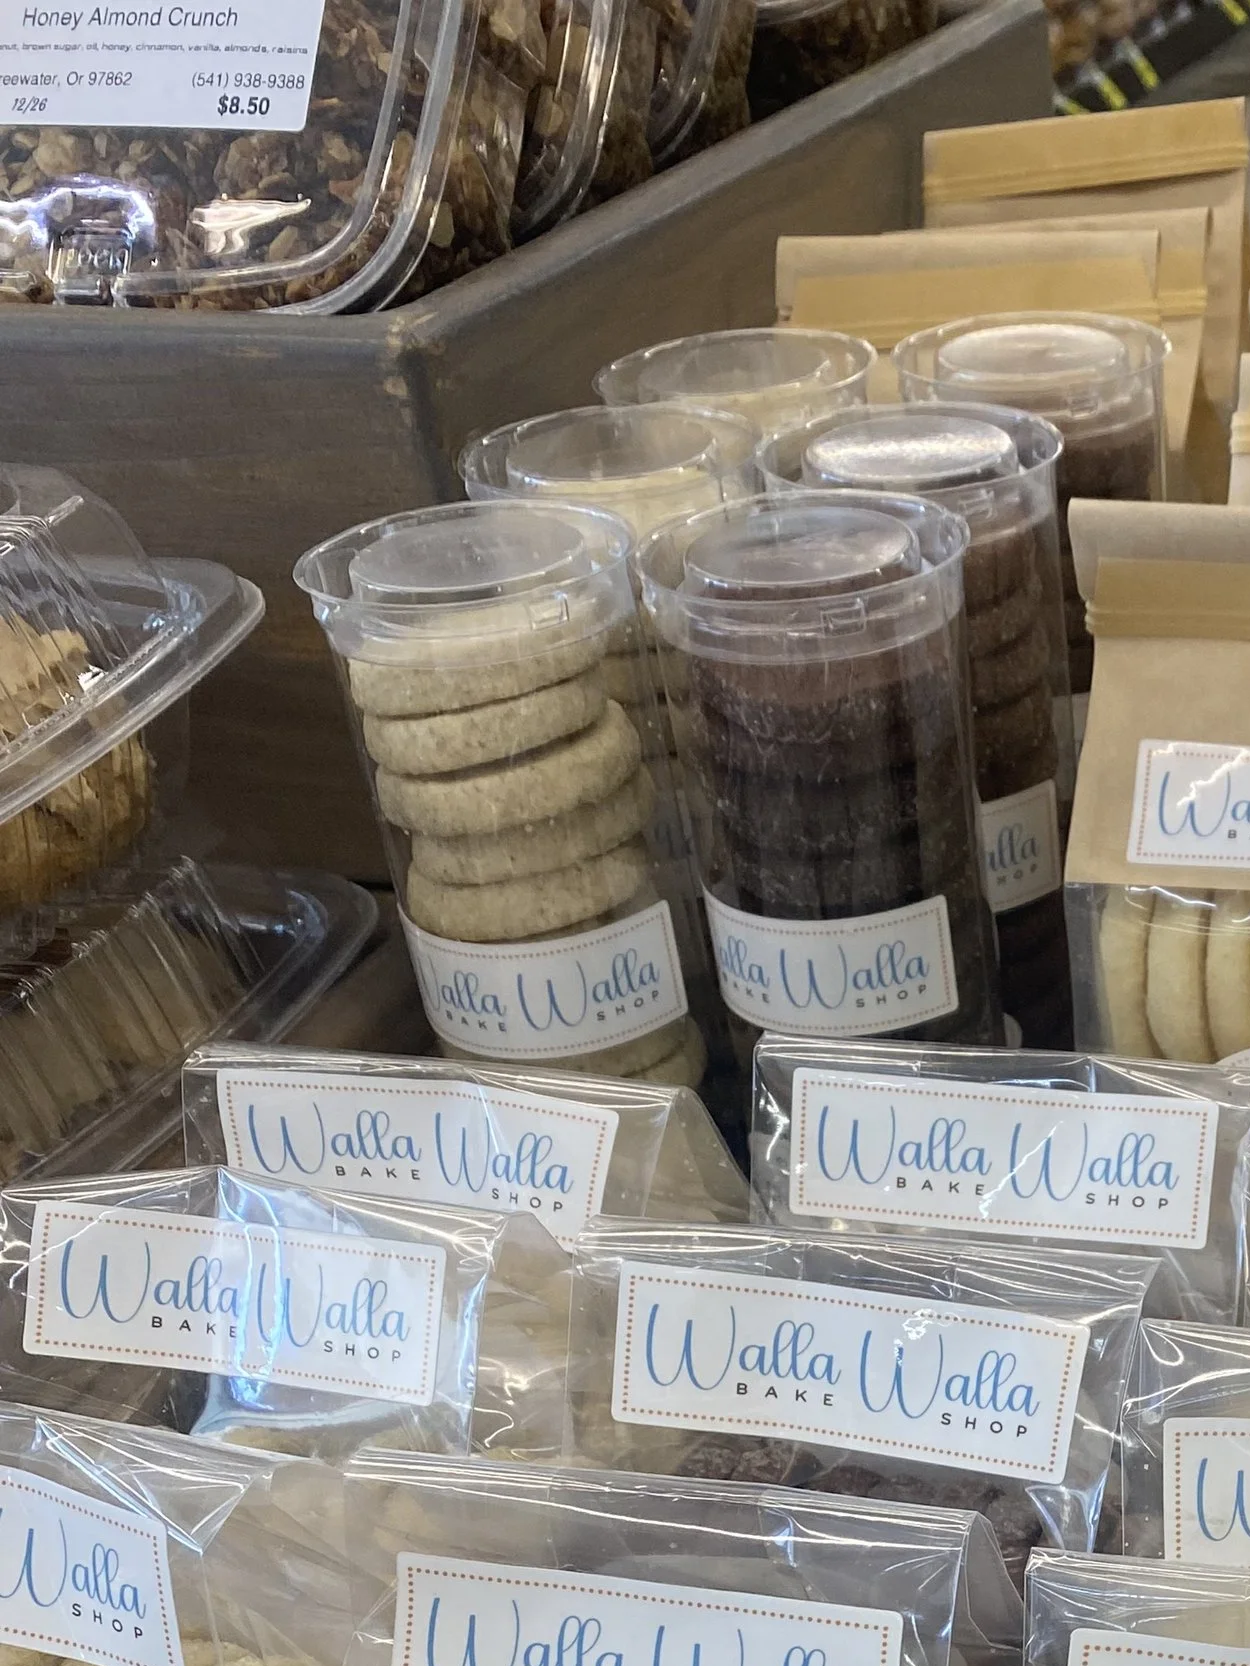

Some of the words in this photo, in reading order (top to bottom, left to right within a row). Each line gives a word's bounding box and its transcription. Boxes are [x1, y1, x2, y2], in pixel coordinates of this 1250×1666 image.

[22, 7, 82, 31] Honey
[88, 7, 162, 27] Almond
[168, 7, 238, 27] Crunch
[22, 42, 51, 50] brown
[101, 42, 133, 52] honey,
[135, 42, 185, 51] cinnamon,
[188, 43, 221, 52] vanilla,
[224, 43, 270, 54] almonds,
[272, 44, 308, 54] raisins
[66, 71, 84, 86] Or
[88, 71, 133, 86] 97862
[191, 72, 229, 88] (541)
[233, 73, 306, 89] 938-9388
[11, 96, 48, 114] 12/26
[217, 94, 270, 116] $8.50
[517, 947, 660, 1032] Walla
[779, 940, 929, 1009] Walla
[597, 990, 660, 1022] SHOP
[856, 983, 928, 1009] SHOP
[248, 1102, 421, 1174] Walla
[435, 1112, 574, 1194] Walla
[818, 1105, 991, 1185] Walla
[1010, 1122, 1179, 1201] Walla
[336, 1165, 421, 1181] BAKE
[491, 1187, 565, 1212] SHOP
[896, 1176, 986, 1196] BAKE
[1085, 1191, 1170, 1210] SHOP
[60, 1239, 240, 1324] Walla
[256, 1262, 410, 1348] Walla
[151, 1315, 238, 1338] BAKE
[323, 1340, 402, 1362] SHOP
[645, 1303, 843, 1392] Walla
[858, 1328, 1040, 1419] Walla
[735, 1381, 836, 1407] BAKE
[940, 1411, 1029, 1439] SHOP
[72, 1602, 143, 1639] SHOP
